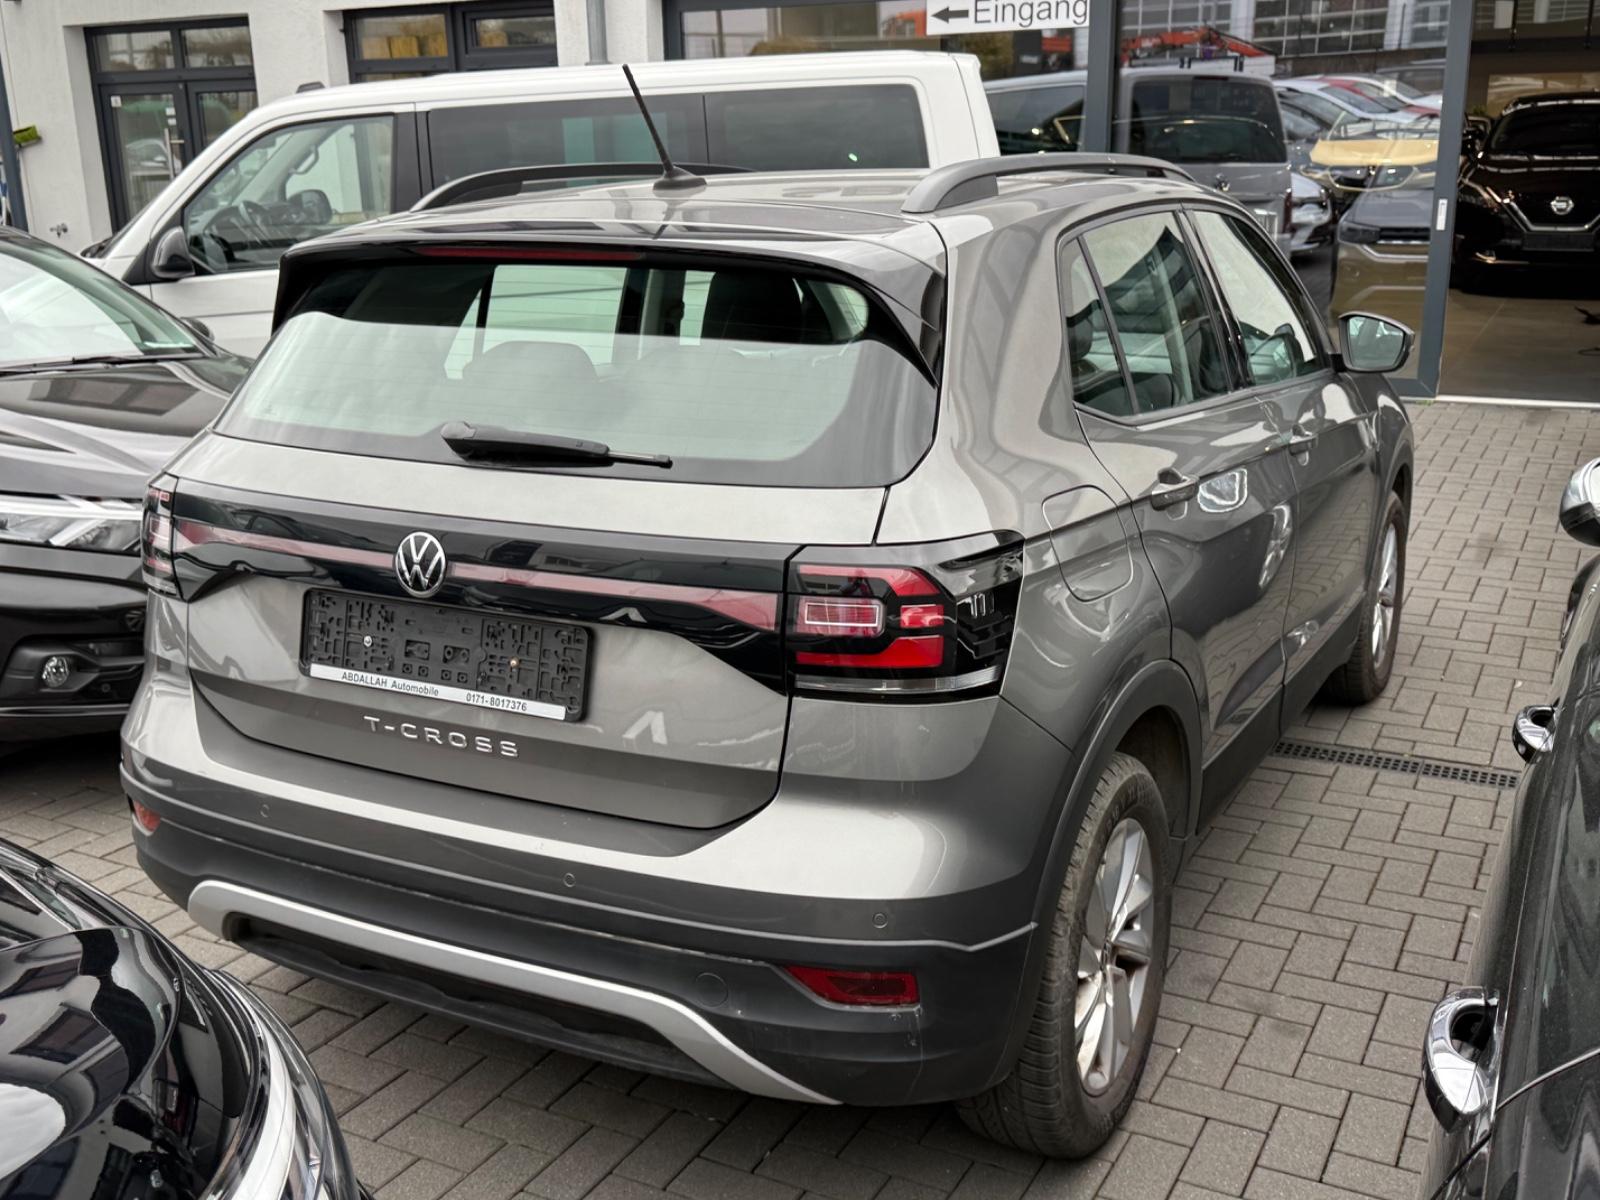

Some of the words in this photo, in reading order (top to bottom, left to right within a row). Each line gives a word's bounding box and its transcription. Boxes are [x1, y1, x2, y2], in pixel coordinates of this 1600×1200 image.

[974, 0, 1088, 28] Eingang
[341, 671, 388, 688] ABDALLAH
[390, 680, 440, 697] Automobile
[465, 692, 528, 712] 0171-8017376
[363, 715, 519, 758] T-CROSS
